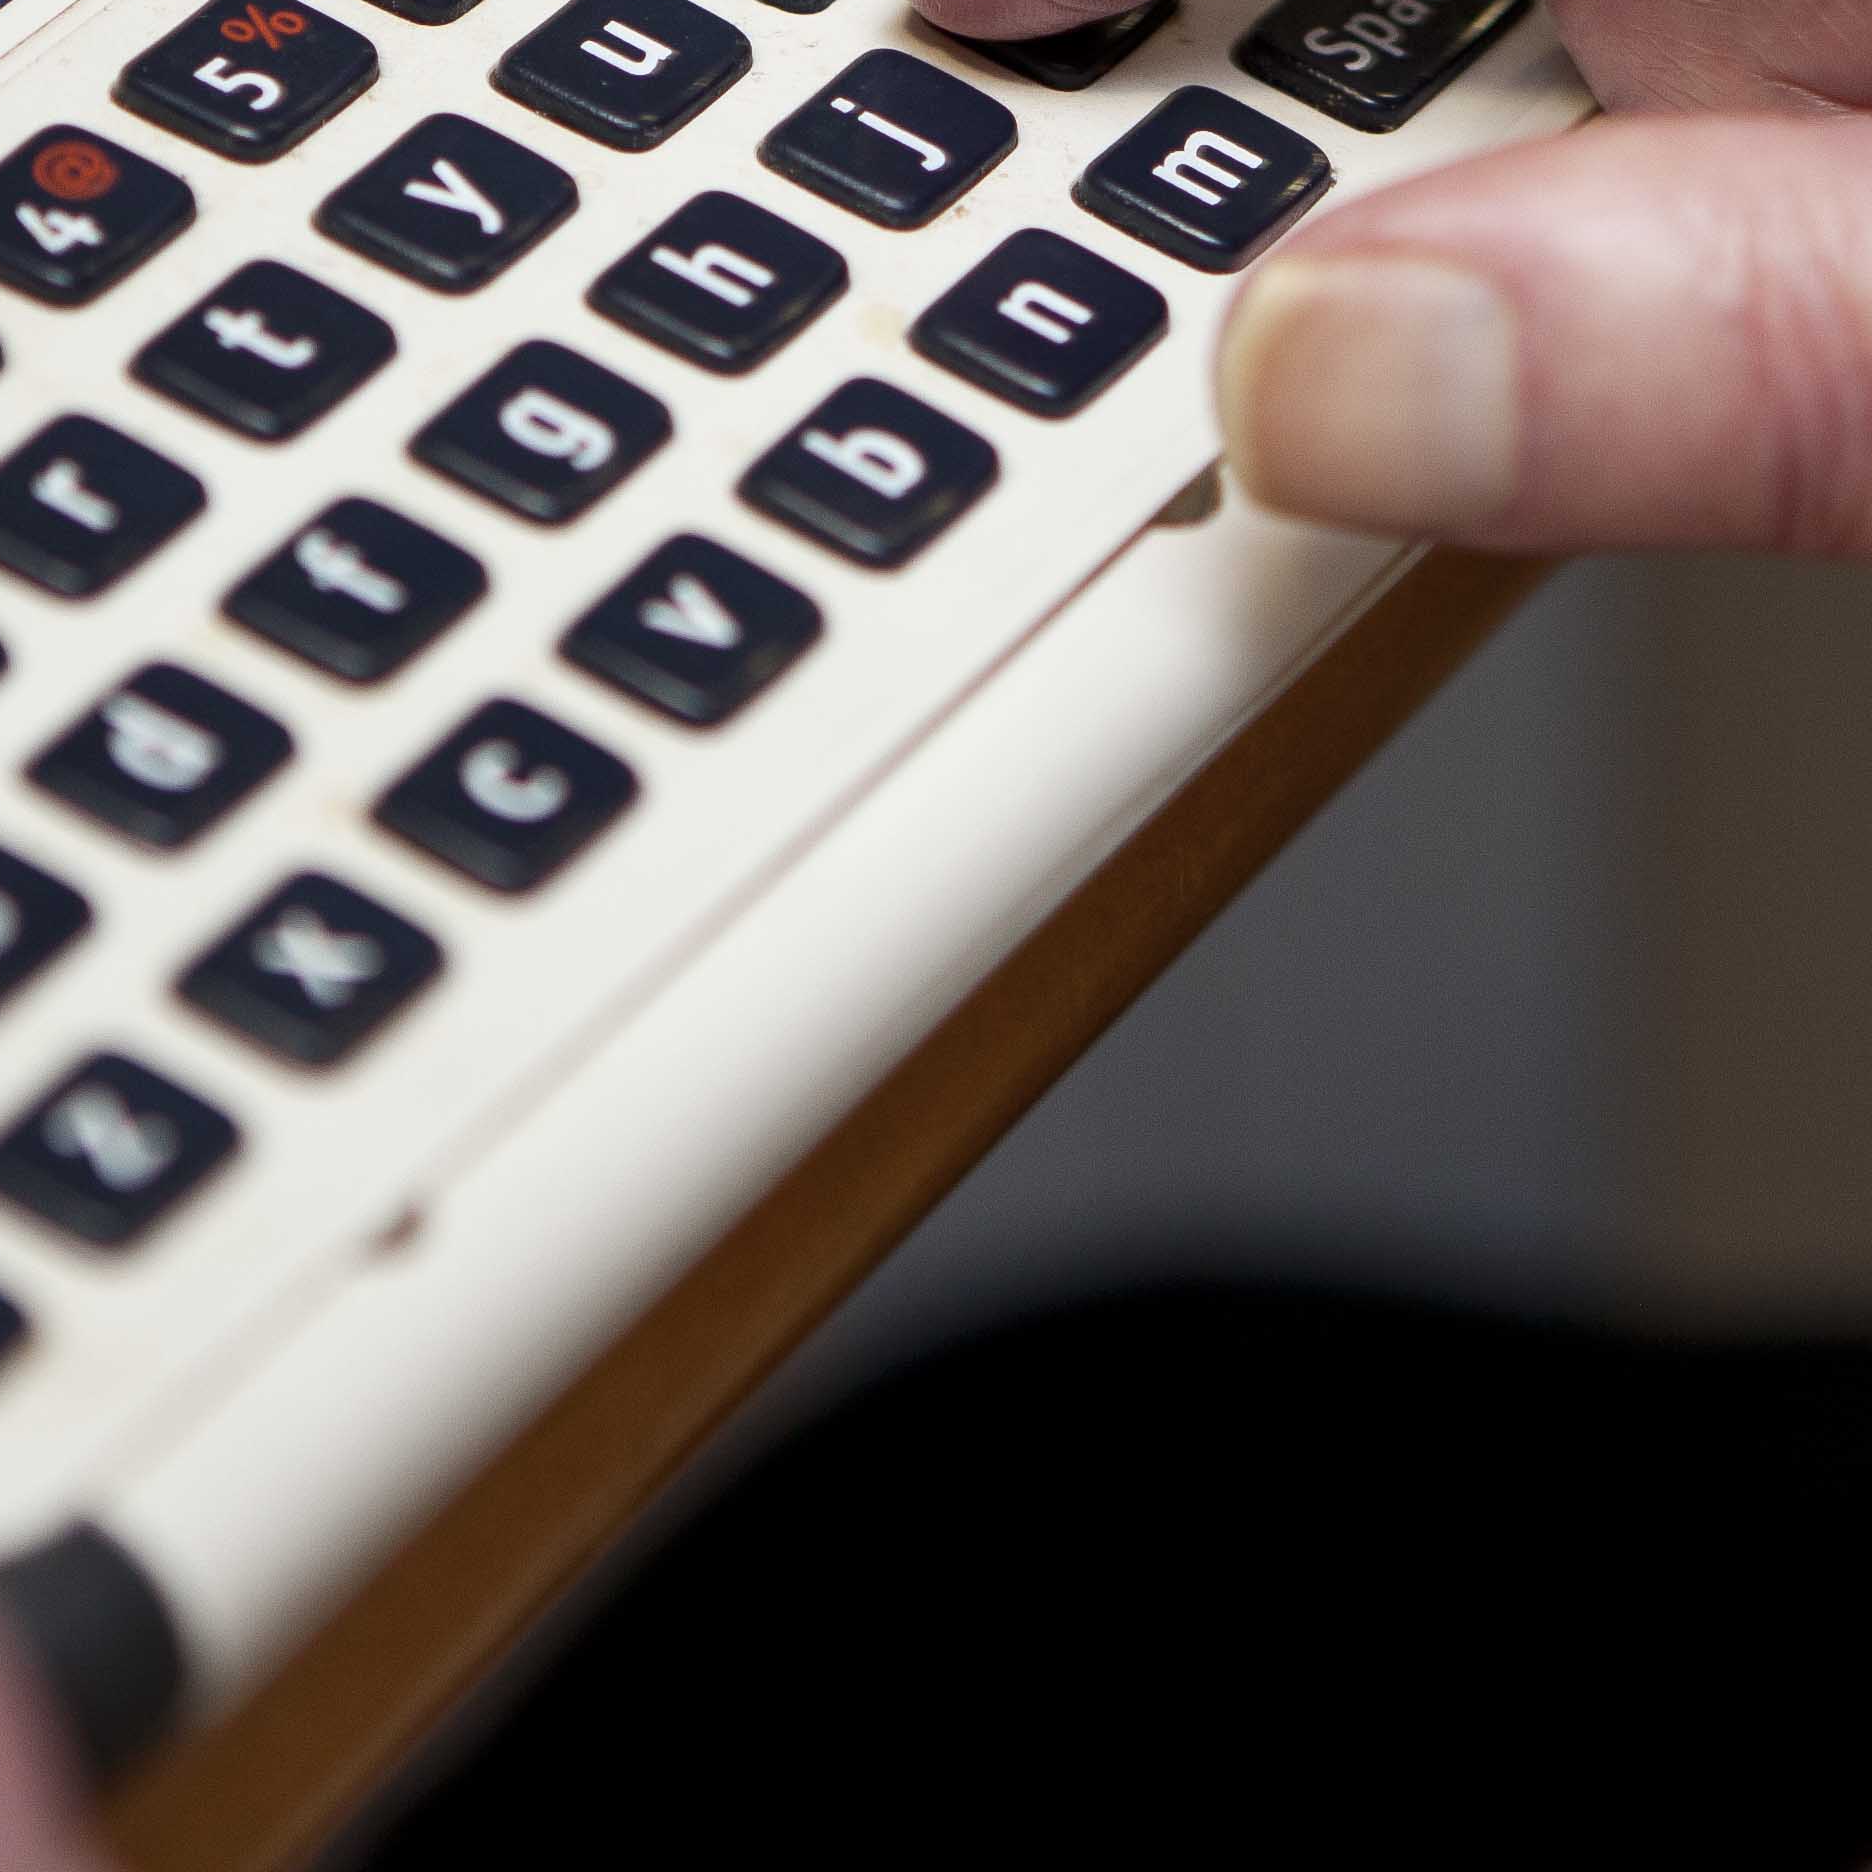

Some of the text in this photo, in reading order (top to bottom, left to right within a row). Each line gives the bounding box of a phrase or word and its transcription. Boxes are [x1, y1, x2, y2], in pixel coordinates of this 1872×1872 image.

[194, 2, 310, 110] 5 %
[581, 20, 674, 76] u
[831, 97, 948, 171] j
[1152, 130, 1265, 205] m
[17, 139, 121, 253] 4 @
[404, 159, 503, 234] y
[651, 244, 774, 306] h
[998, 282, 1092, 343] n
[205, 309, 314, 367] t
[500, 389, 615, 470] g
[803, 429, 925, 498] b
[35, 462, 112, 529] r
[292, 524, 404, 611] f
[645, 578, 737, 647] v
[102, 691, 220, 790] d
[458, 737, 569, 823] c
[254, 904, 382, 1005] x
[42, 1083, 180, 1188] z
